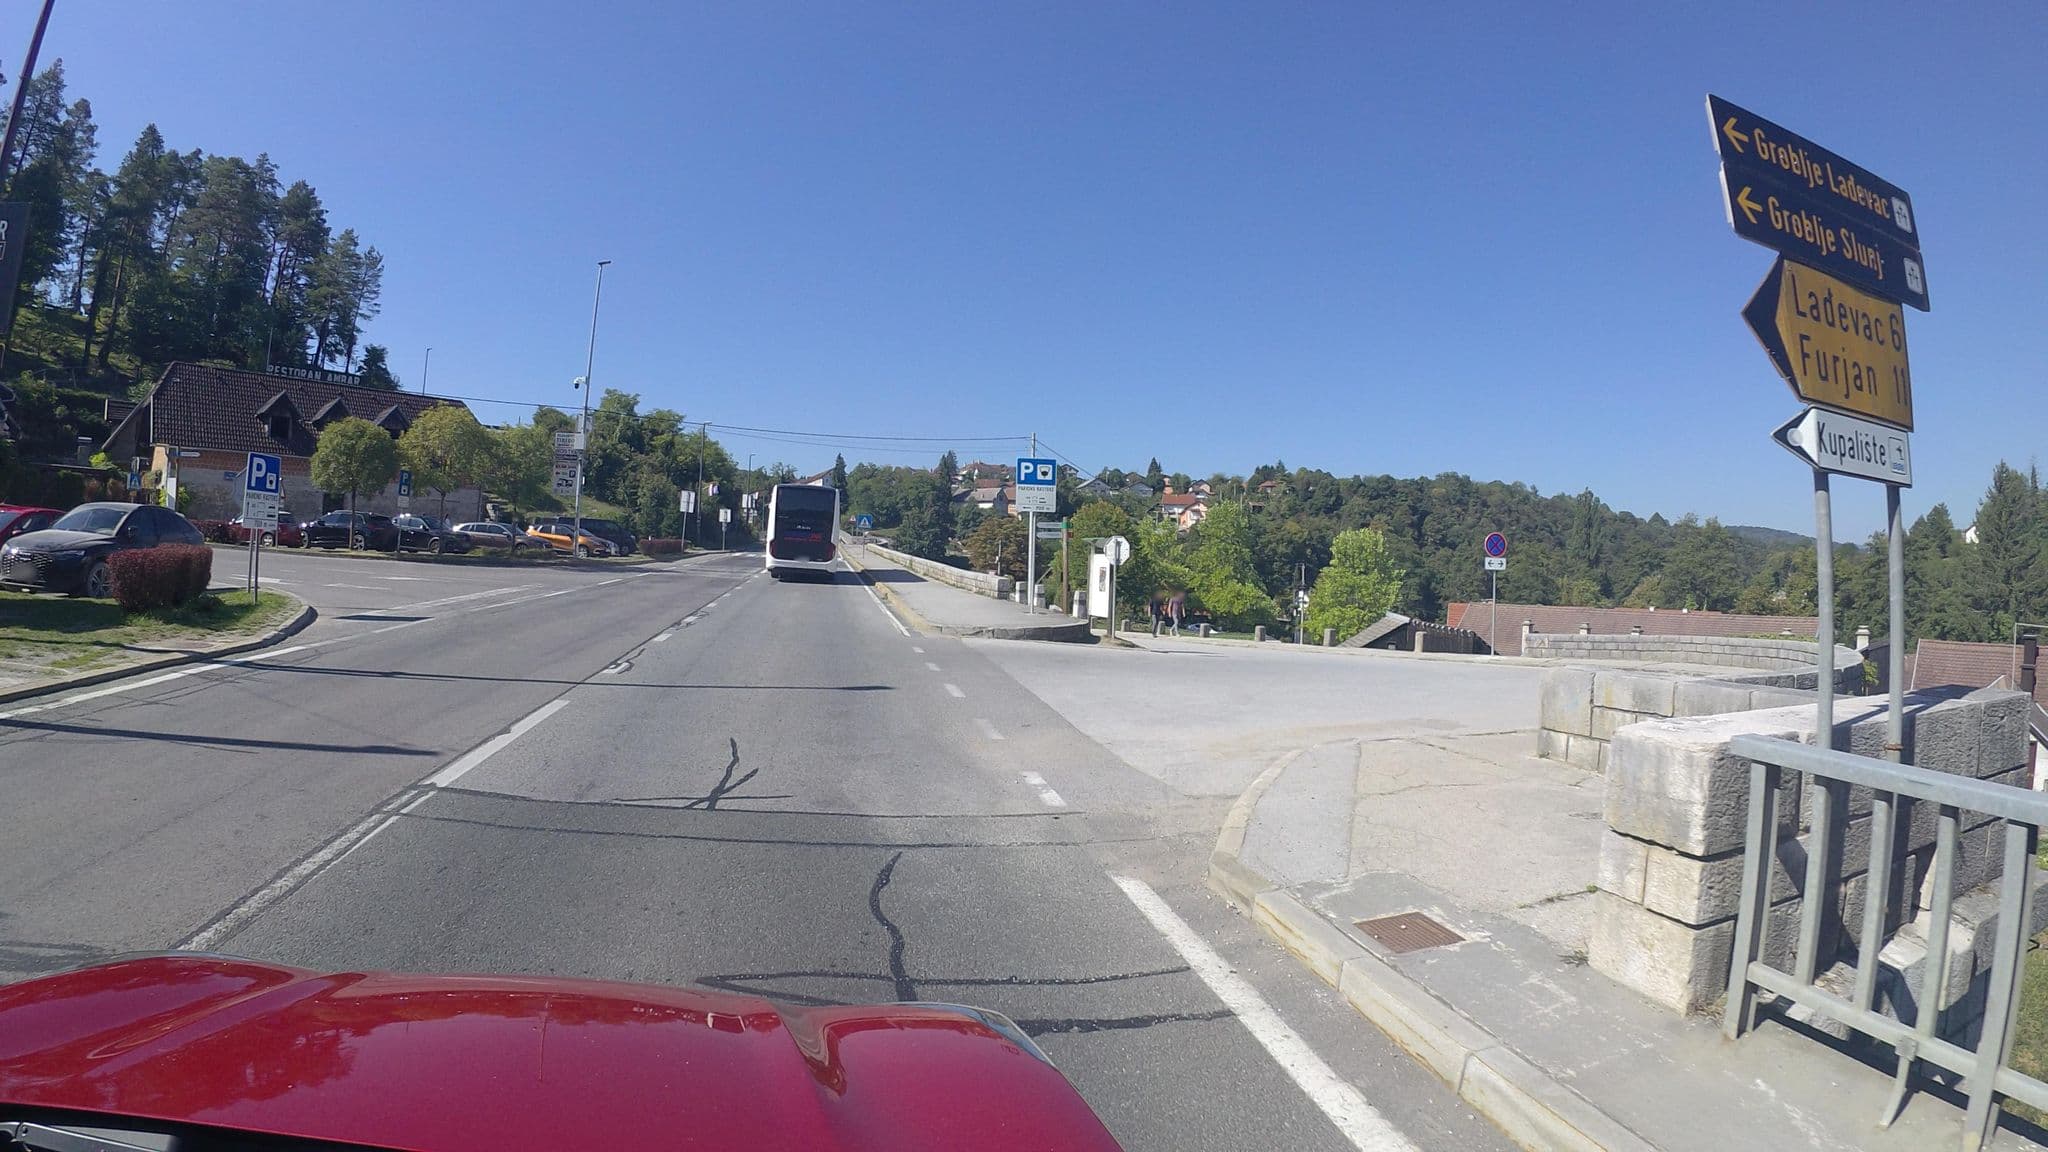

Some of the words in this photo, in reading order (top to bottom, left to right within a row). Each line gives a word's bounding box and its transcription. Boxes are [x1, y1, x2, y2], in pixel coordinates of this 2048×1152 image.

[1754, 128, 1824, 188] Groblje
[1826, 162, 1891, 219] Lađevac
[1767, 196, 1836, 256] Groblje
[1840, 227, 1884, 280] Slunj
[1791, 273, 1884, 346] Lađevac
[1889, 313, 1902, 353] 6
[1799, 333, 1878, 399] Furjan
[1893, 365, 1908, 406] 11
[251, 457, 267, 487] P
[1020, 462, 1034, 480] P
[1817, 421, 1887, 466] Kupalište
